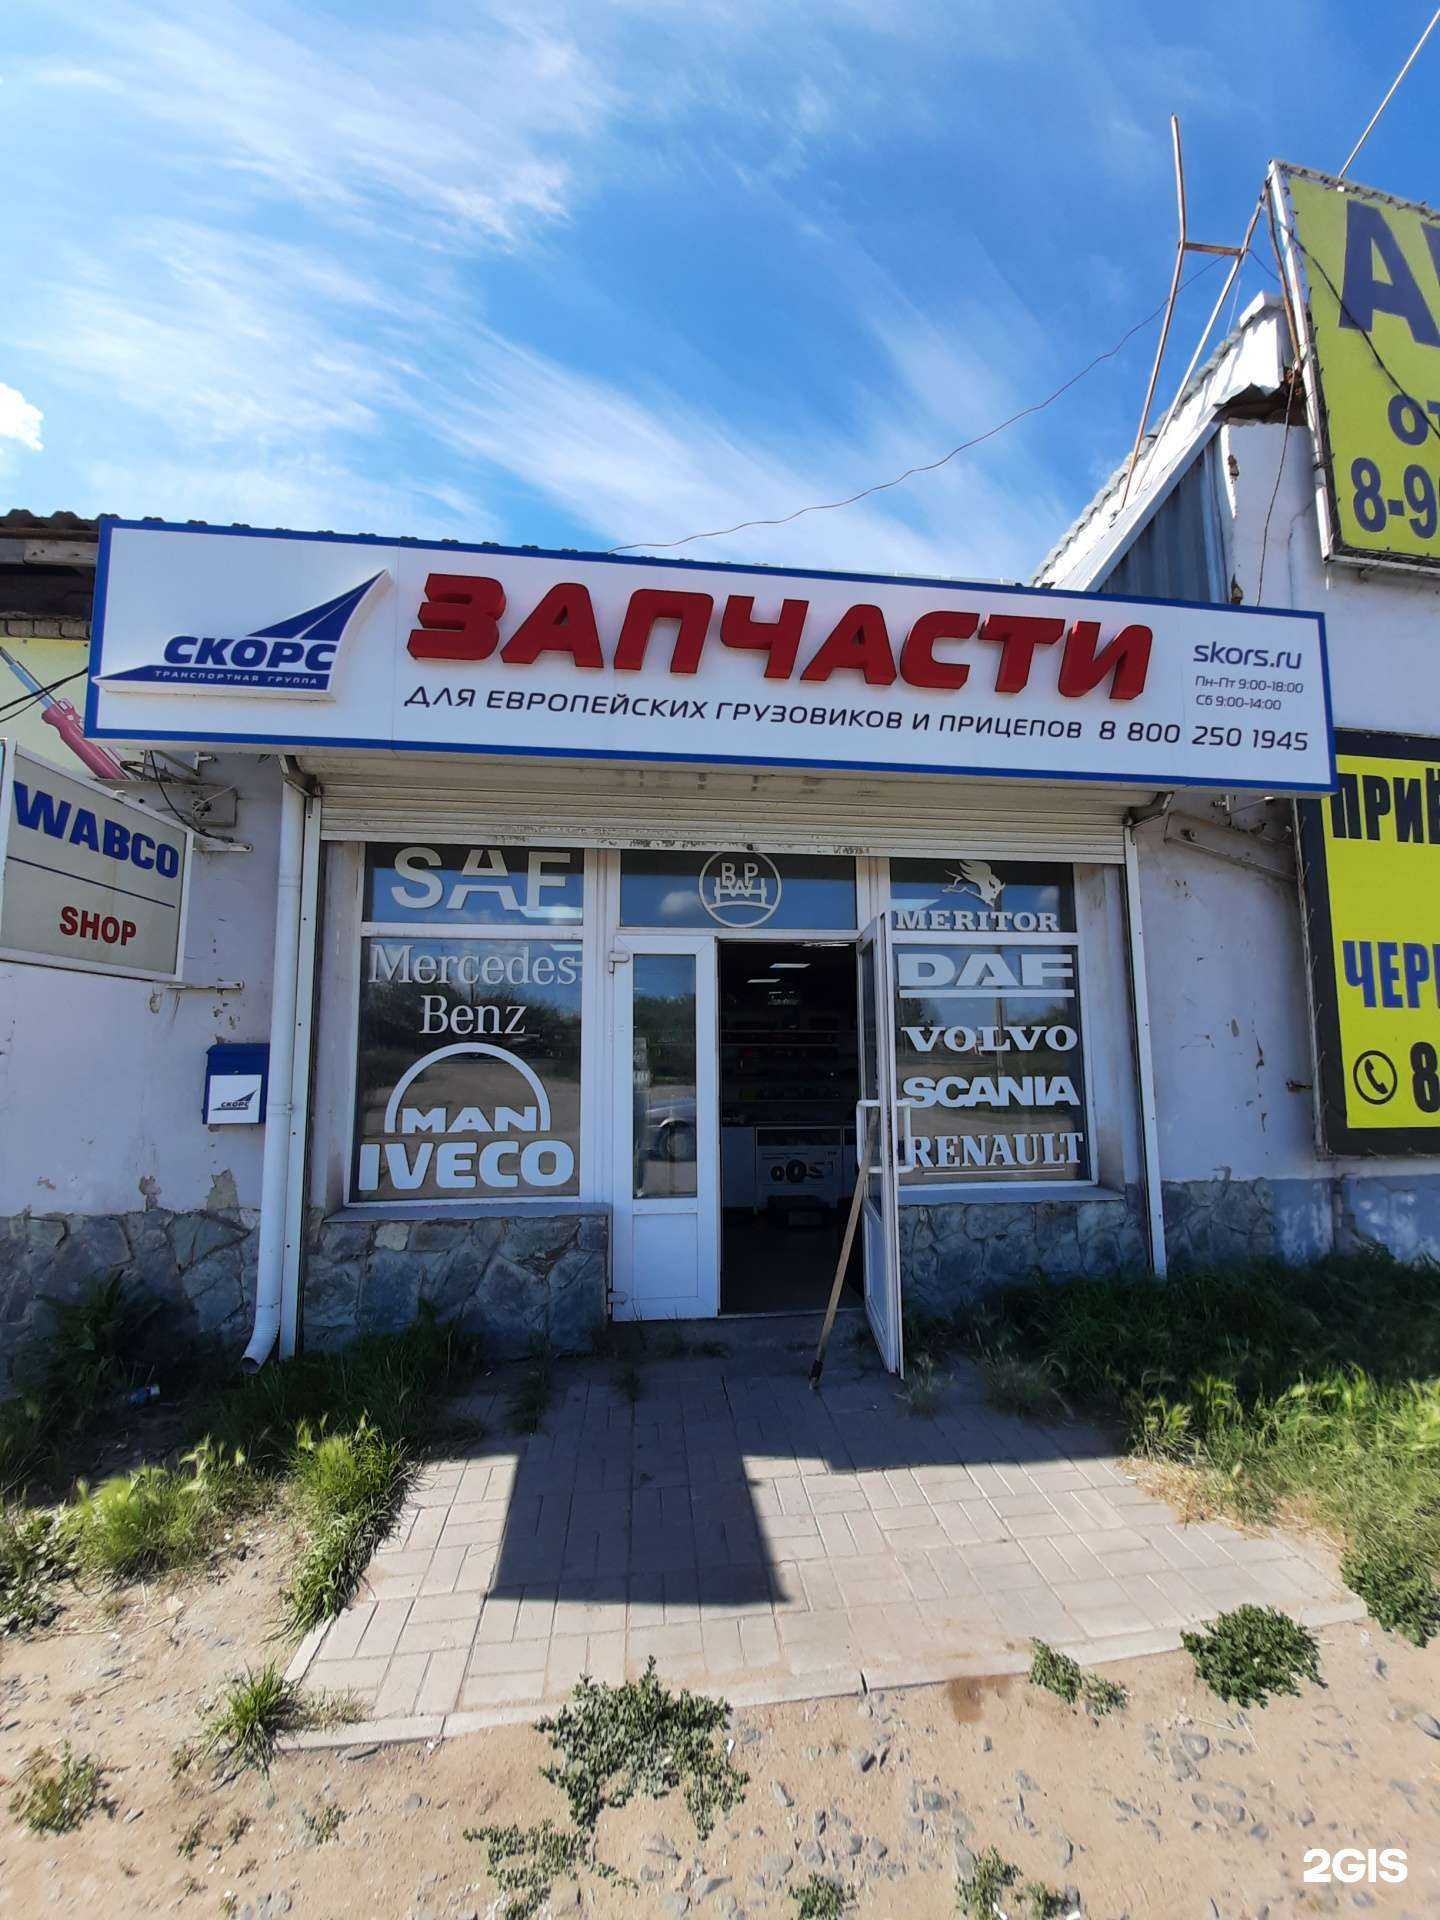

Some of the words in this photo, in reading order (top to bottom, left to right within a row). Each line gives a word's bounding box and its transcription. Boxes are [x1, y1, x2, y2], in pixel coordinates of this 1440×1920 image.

[1339, 199, 1440, 349] А
[164, 635, 337, 672] СКОРС
[406, 573, 1153, 700] ЗАПЧАСТИ
[1193, 641, 1302, 670] skors.ru
[155, 670, 259, 682] ТРАНСПОРТНАЯ
[267, 675, 318, 685] ГРУППА
[1195, 675, 1236, 689] Пн-Пт
[1238, 678, 1304, 694] 9:00-18:00
[404, 686, 476, 708] ДЛЯ
[486, 690, 708, 719] ЕВРОПЕЙСКИХ
[716, 702, 902, 729] ГРУЗОВИКОВ
[912, 713, 929, 731] И
[939, 714, 1082, 739] ПРИЦЕПОВ
[1099, 721, 1116, 740] 8
[1127, 722, 1181, 743] 800
[1192, 725, 1242, 747] 250
[1252, 729, 1308, 751] 1945
[1196, 694, 1213, 706] Сб
[1215, 695, 1282, 710] 9:00-14:00
[14, 780, 180, 879] WABCO
[390, 846, 571, 912] SAF
[59, 906, 137, 946] SHOP
[896, 910, 1060, 932] MERITOR
[898, 953, 1074, 987] DAF
[1343, 940, 1440, 1009] ЧЕР
[419, 995, 528, 1034] Benz
[901, 1025, 1078, 1051] VOLVO
[903, 1076, 1080, 1108] SCANIA
[1410, 1041, 1440, 1113] 8
[401, 1106, 540, 1134] MAN
[358, 1140, 575, 1191] IVECO
[908, 1132, 1084, 1168] RENAULT
